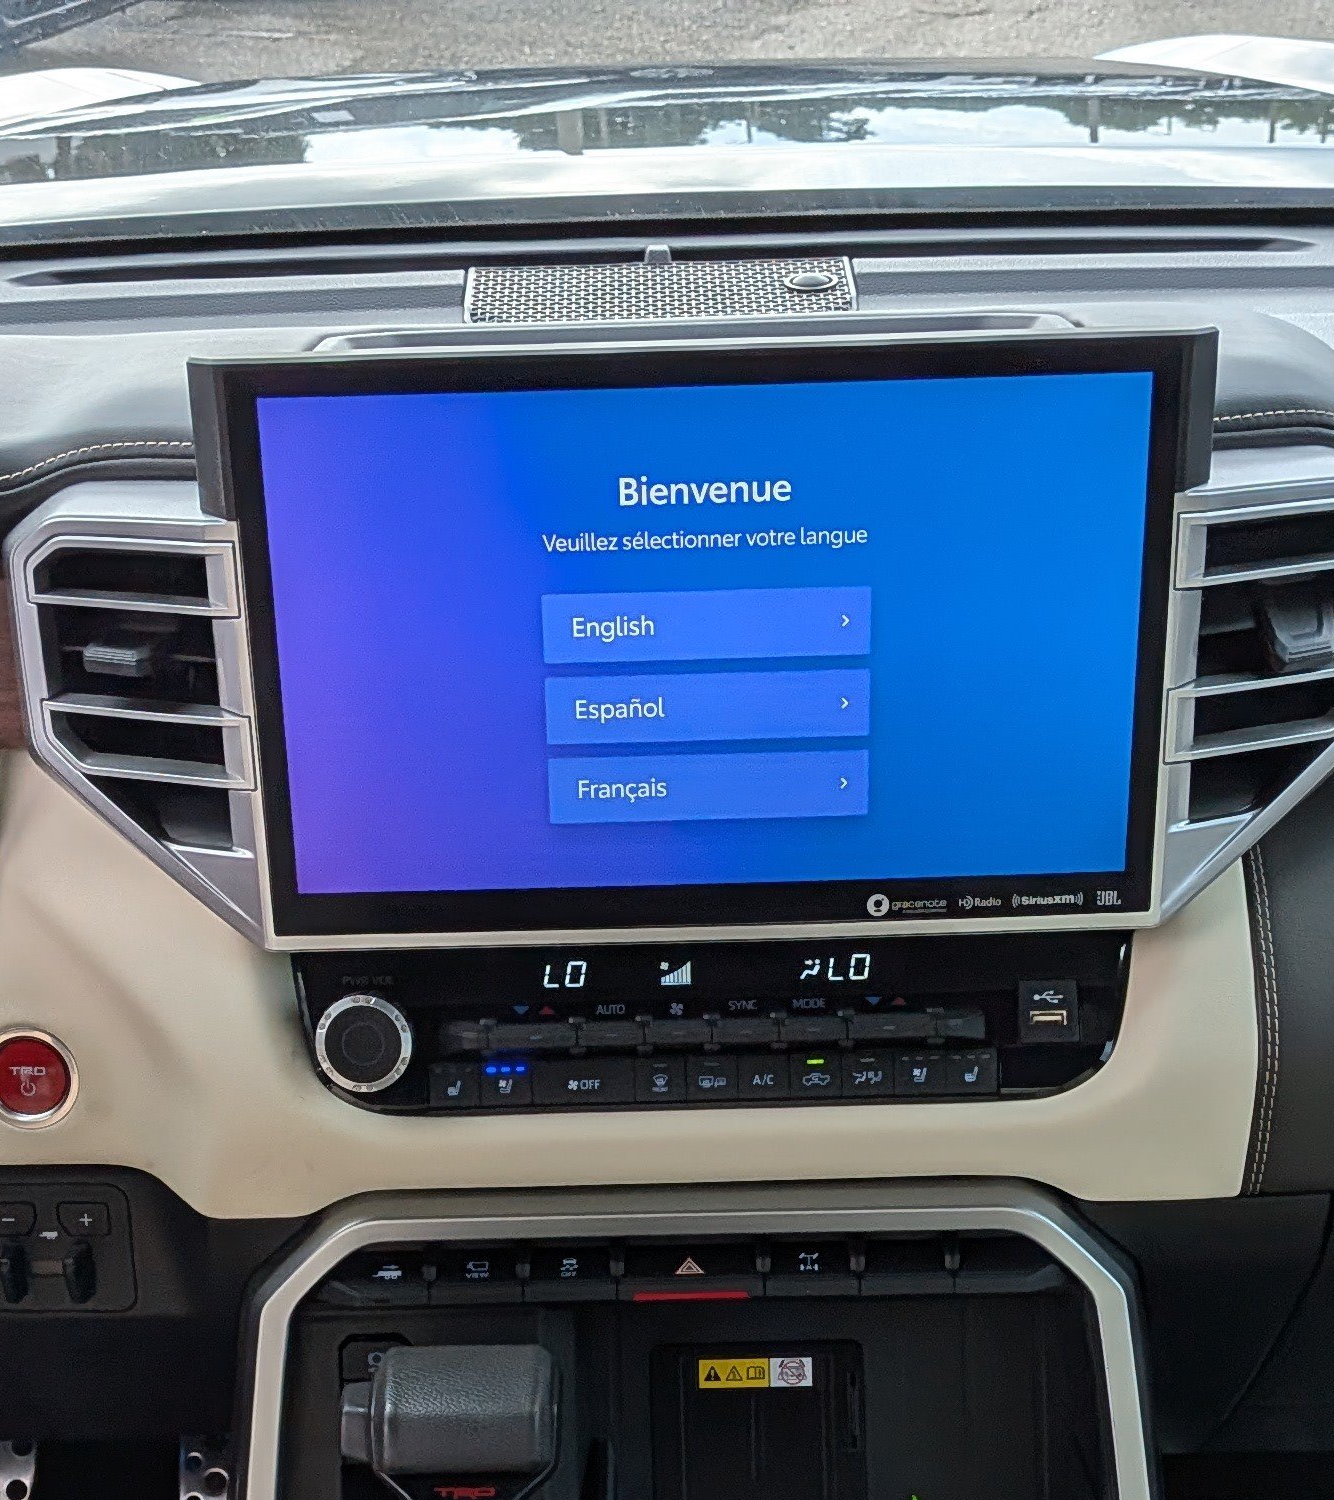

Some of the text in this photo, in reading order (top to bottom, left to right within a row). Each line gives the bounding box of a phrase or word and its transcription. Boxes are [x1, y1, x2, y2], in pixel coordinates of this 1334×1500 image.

[618, 476, 792, 506] Bienvenue
[541, 526, 868, 552] Veuillez sélectionner votre langue
[571, 614, 655, 643] English
[574, 696, 666, 724] Español
[577, 777, 667, 803] Français
[974, 896, 1002, 908] Radio
[1096, 889, 1122, 906] JBL
[596, 1004, 626, 1016] AUTO
[728, 1000, 758, 1011] SYNC
[792, 998, 826, 1009] MODE
[9, 1065, 46, 1076] TRD
[579, 1079, 601, 1091] OFF
[752, 1073, 774, 1086] A/C
[434, 1486, 496, 1500] TRD
